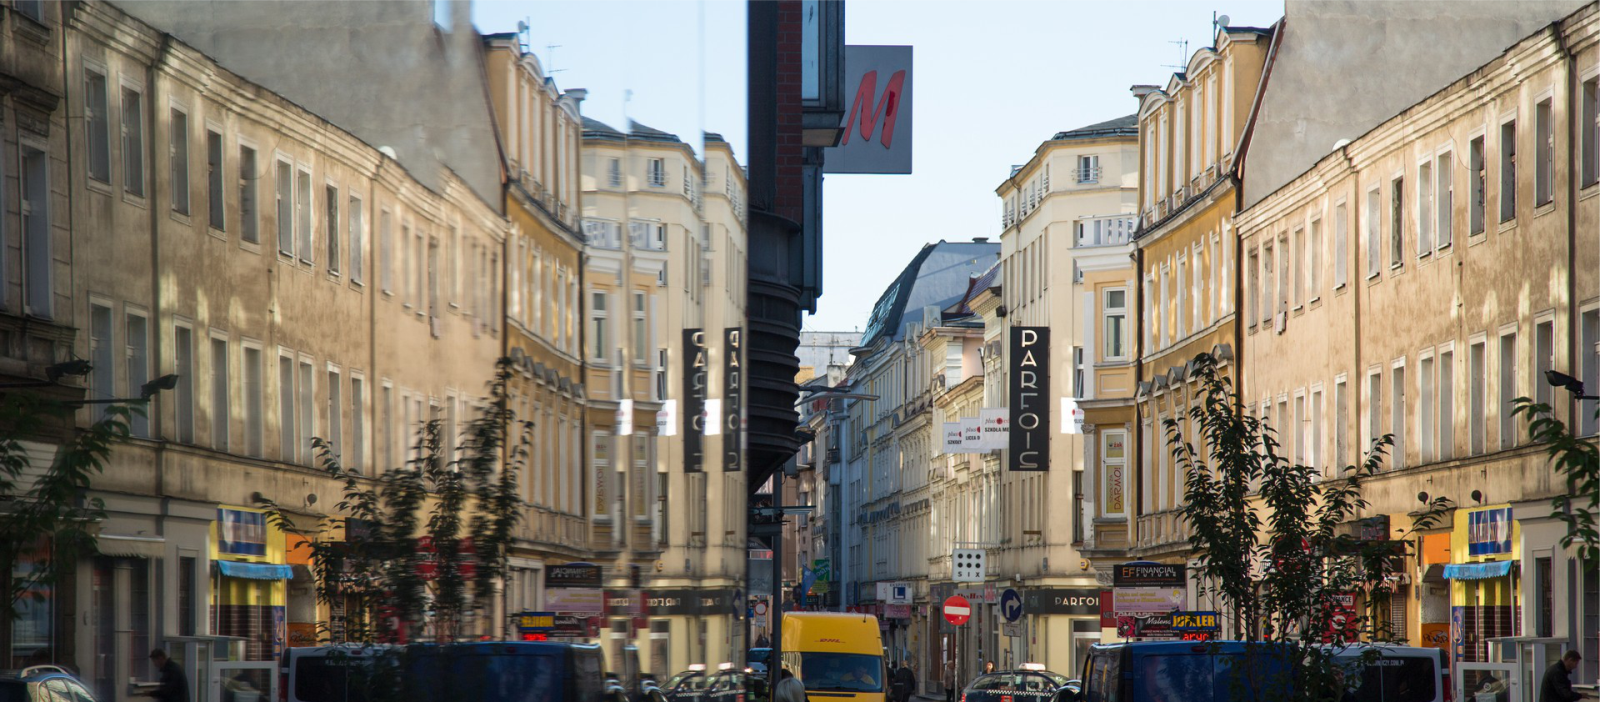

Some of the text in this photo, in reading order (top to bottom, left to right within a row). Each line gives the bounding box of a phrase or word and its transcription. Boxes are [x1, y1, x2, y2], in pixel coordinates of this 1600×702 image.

[842, 69, 906, 150] M
[1018, 329, 1040, 470] PARFOIS
[1113, 467, 1122, 510] DARMO!
